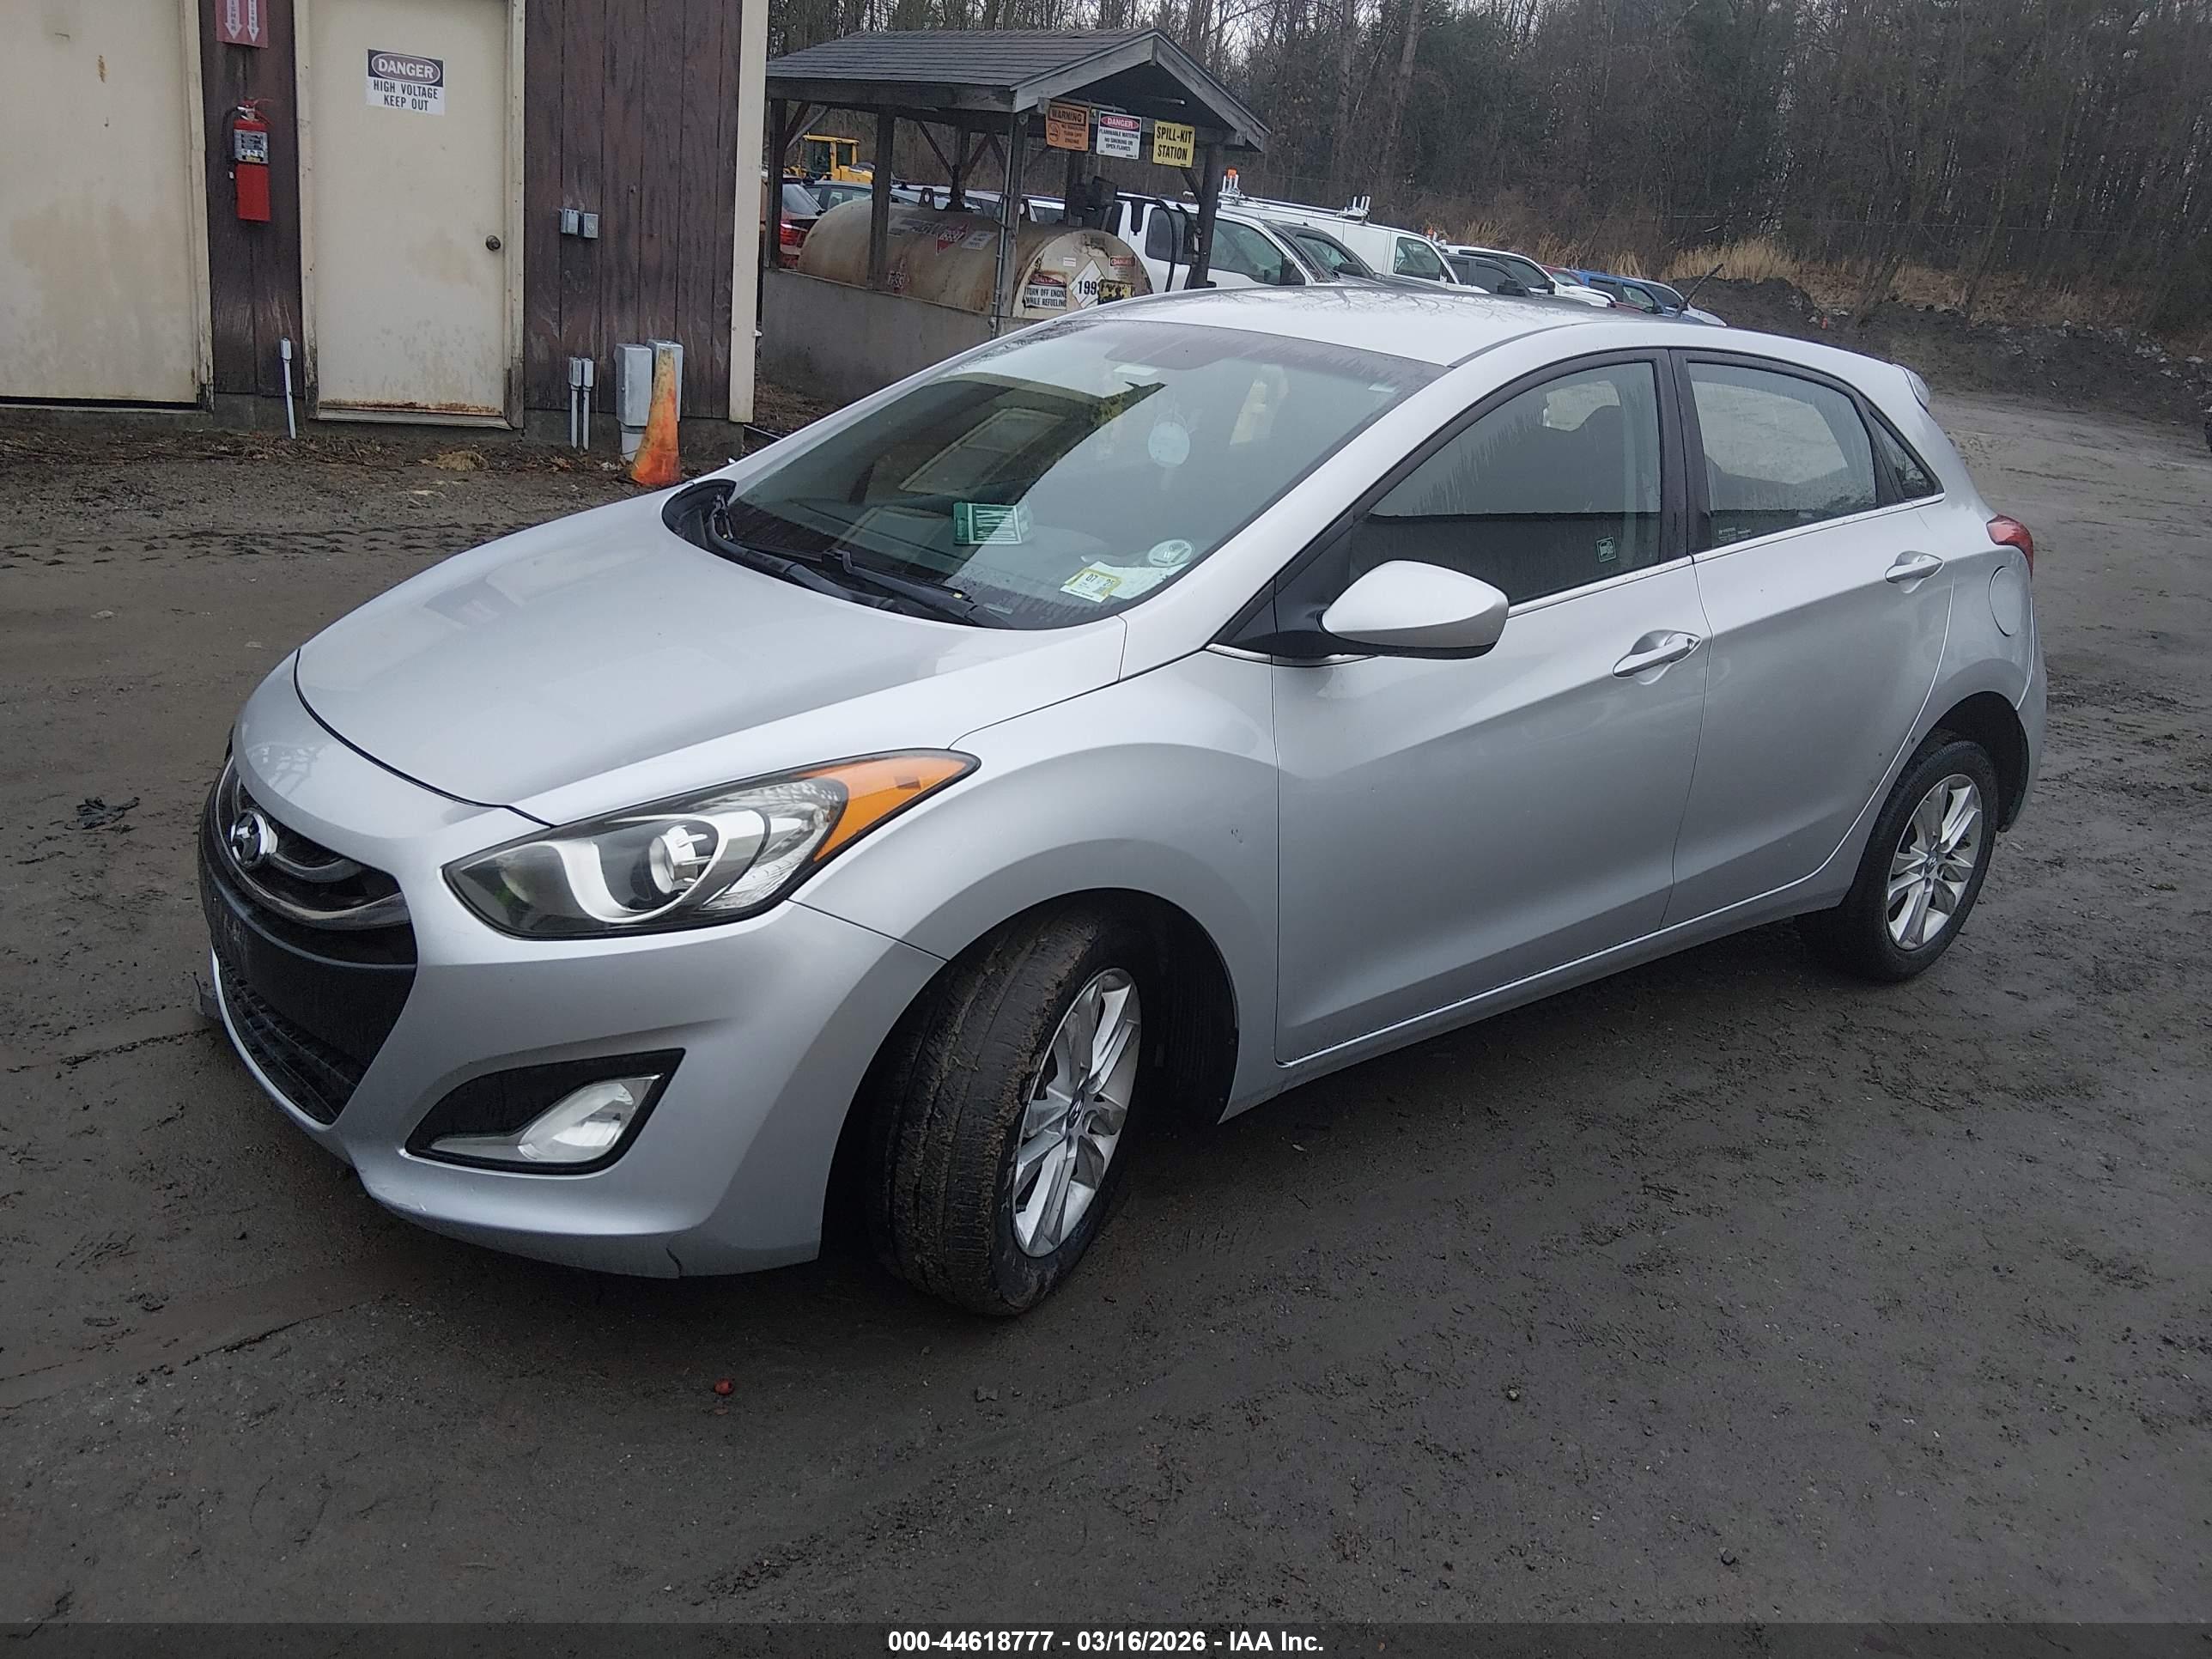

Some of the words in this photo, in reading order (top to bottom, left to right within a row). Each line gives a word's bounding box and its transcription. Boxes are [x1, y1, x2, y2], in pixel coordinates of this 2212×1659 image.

[378, 58, 434, 79] DANGER
[374, 79, 396, 93] HIGH
[401, 83, 439, 100] VOLTAGE
[384, 94, 406, 108] KEEP
[411, 98, 429, 112] OUT
[1051, 109, 1082, 123] WARNING
[1107, 117, 1133, 129] DANGER
[1157, 125, 1193, 143] SPILL-KIT
[1158, 143, 1188, 161] STATION
[1026, 287, 1039, 296] TURN
[1040, 288, 1049, 297] OFF
[1085, 573, 1098, 582] 07
